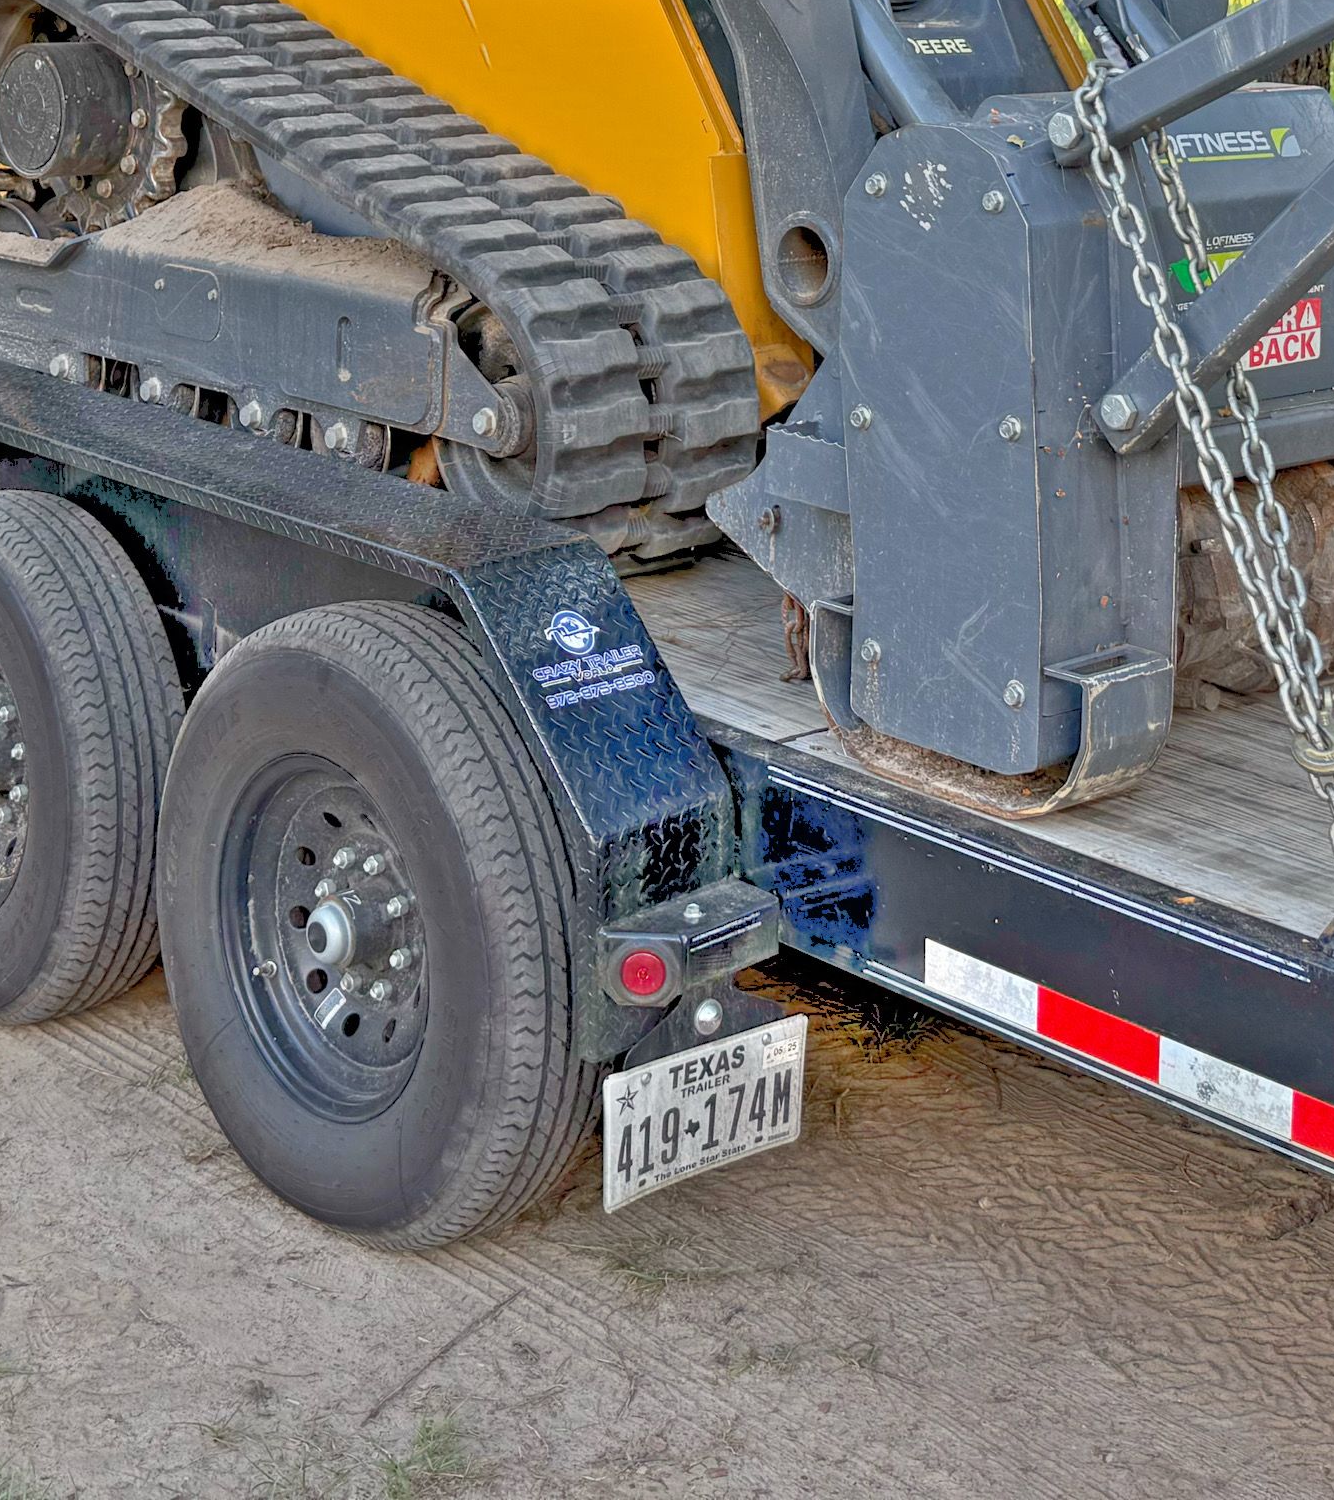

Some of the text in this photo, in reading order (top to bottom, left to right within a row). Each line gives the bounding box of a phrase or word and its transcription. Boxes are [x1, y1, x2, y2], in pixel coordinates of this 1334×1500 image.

[1205, 232, 1255, 248] LOFTNESS
[1249, 331, 1316, 368] BACK
[532, 644, 643, 682] CRAZY TRAILER
[669, 1044, 746, 1090] TEXAS
[680, 1073, 731, 1098] TRAILER
[617, 1067, 793, 1184] 419 174M
[654, 1143, 747, 1183] The Lone Star State
